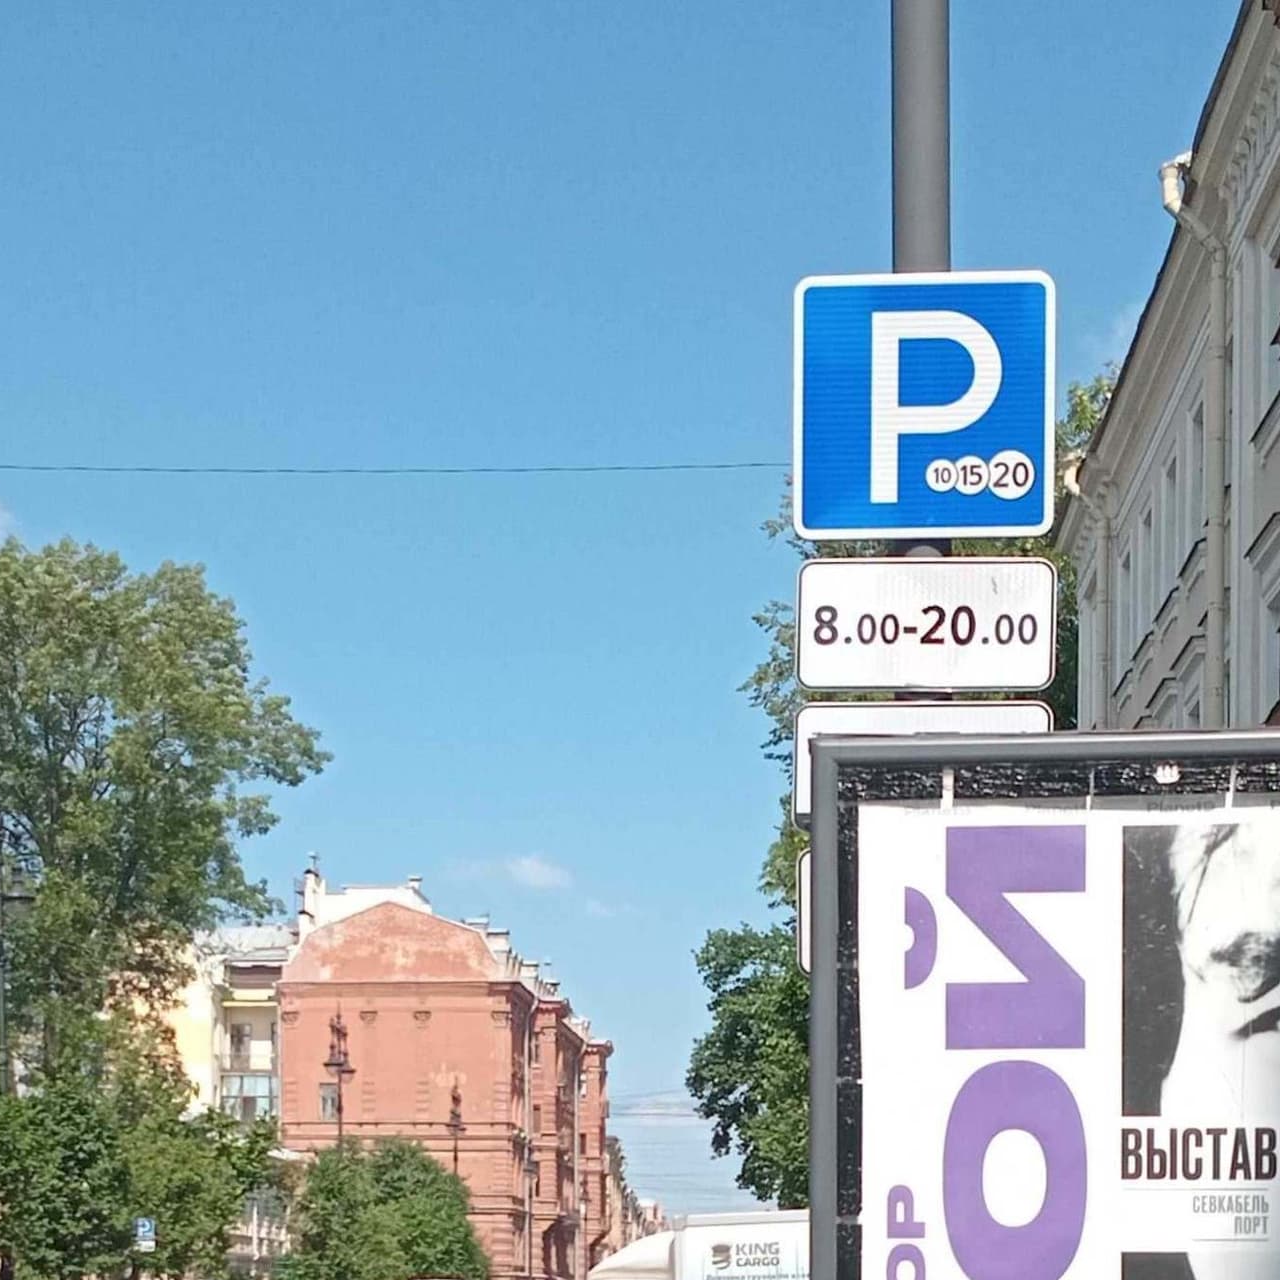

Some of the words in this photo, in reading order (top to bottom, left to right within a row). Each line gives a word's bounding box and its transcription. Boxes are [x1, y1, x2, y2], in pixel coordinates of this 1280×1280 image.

[870, 309, 1003, 504] P
[933, 466, 951, 484] 10
[961, 463, 983, 486] 15
[993, 461, 1030, 488] 20
[812, 604, 1038, 646] 8.00-20.00
[1192, 1195, 1269, 1214] СЕВКАБЕЛЬ
[1233, 1215, 1269, 1235] ПОРТ
[735, 1241, 780, 1256] KING
[735, 1256, 780, 1268] CARGO
